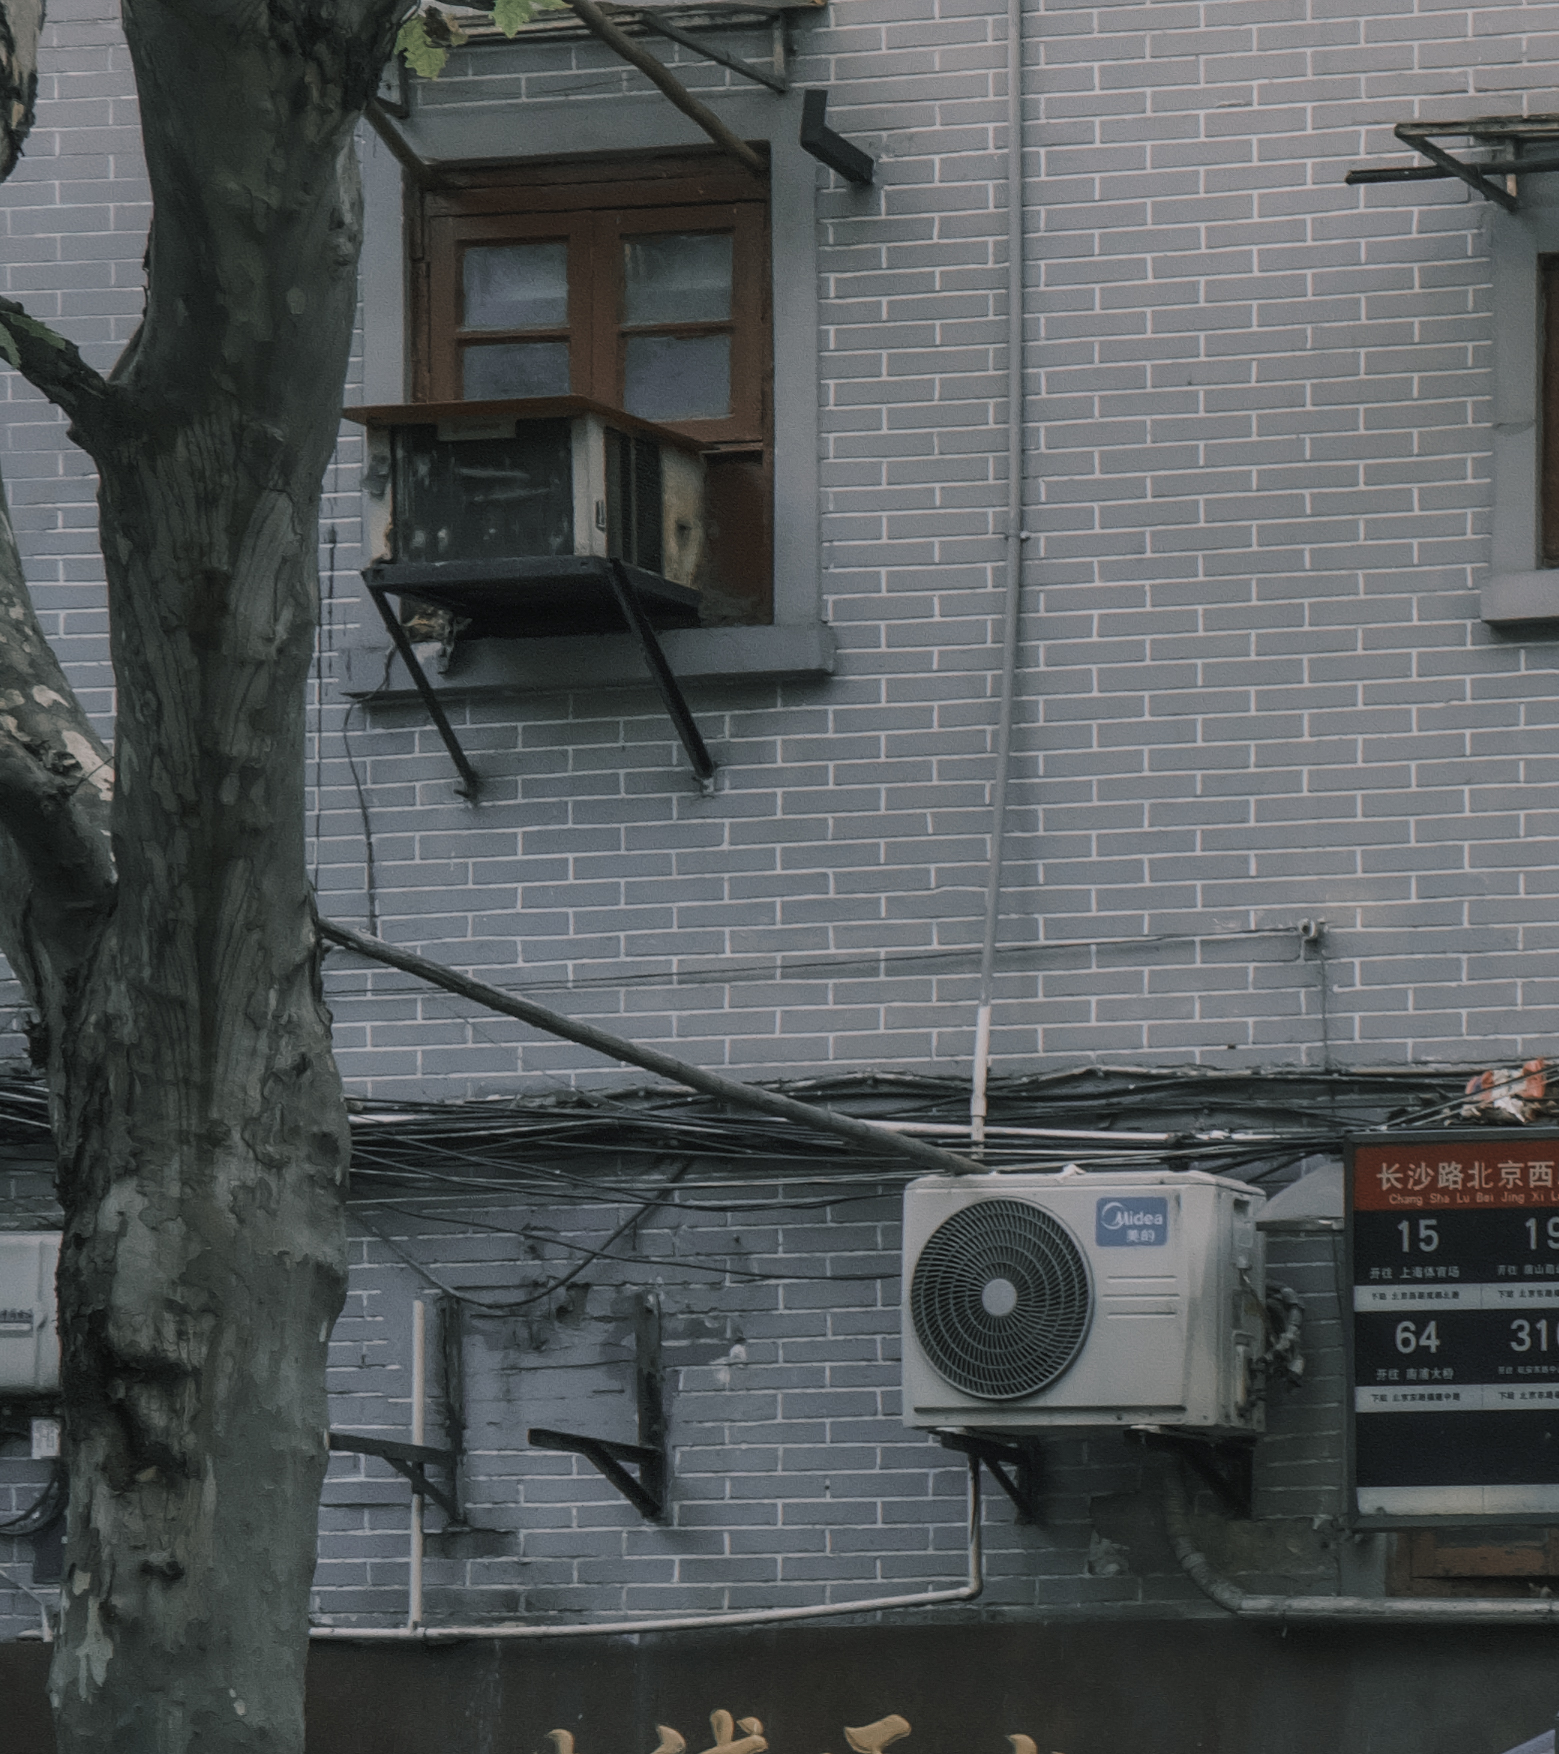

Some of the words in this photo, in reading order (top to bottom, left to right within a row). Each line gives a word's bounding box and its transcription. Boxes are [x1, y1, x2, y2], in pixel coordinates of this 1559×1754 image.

[1389, 1193, 1423, 1206] Chang
[1430, 1193, 1450, 1204] Sha
[1501, 1191, 1525, 1204] Jing
[1112, 1211, 1164, 1226] Midea
[1126, 1229, 1155, 1243] 美的
[1397, 1219, 1440, 1252] 15
[1395, 1320, 1441, 1353] 64
